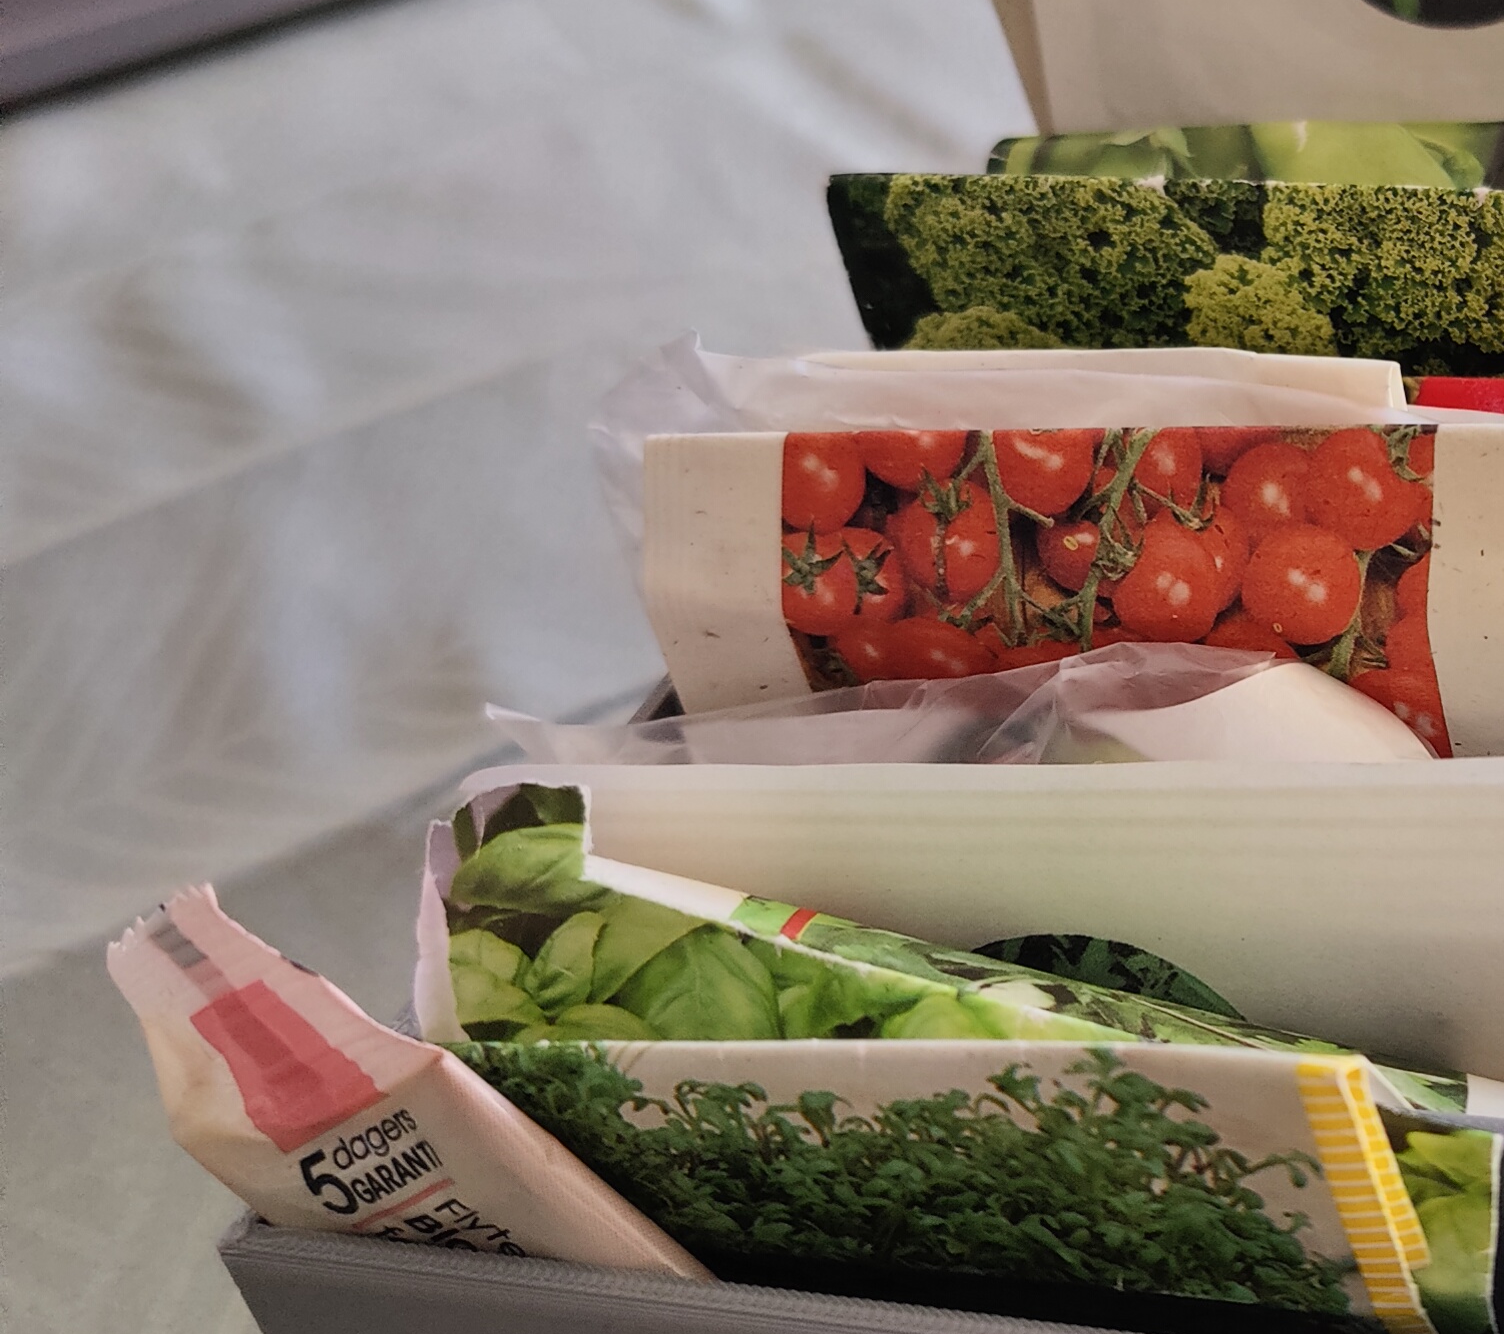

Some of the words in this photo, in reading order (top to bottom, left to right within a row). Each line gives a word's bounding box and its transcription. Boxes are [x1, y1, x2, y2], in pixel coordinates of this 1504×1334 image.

[299, 1149, 359, 1215] 5
[332, 1108, 418, 1170] dagers
[351, 1139, 444, 1204] GARANTI
